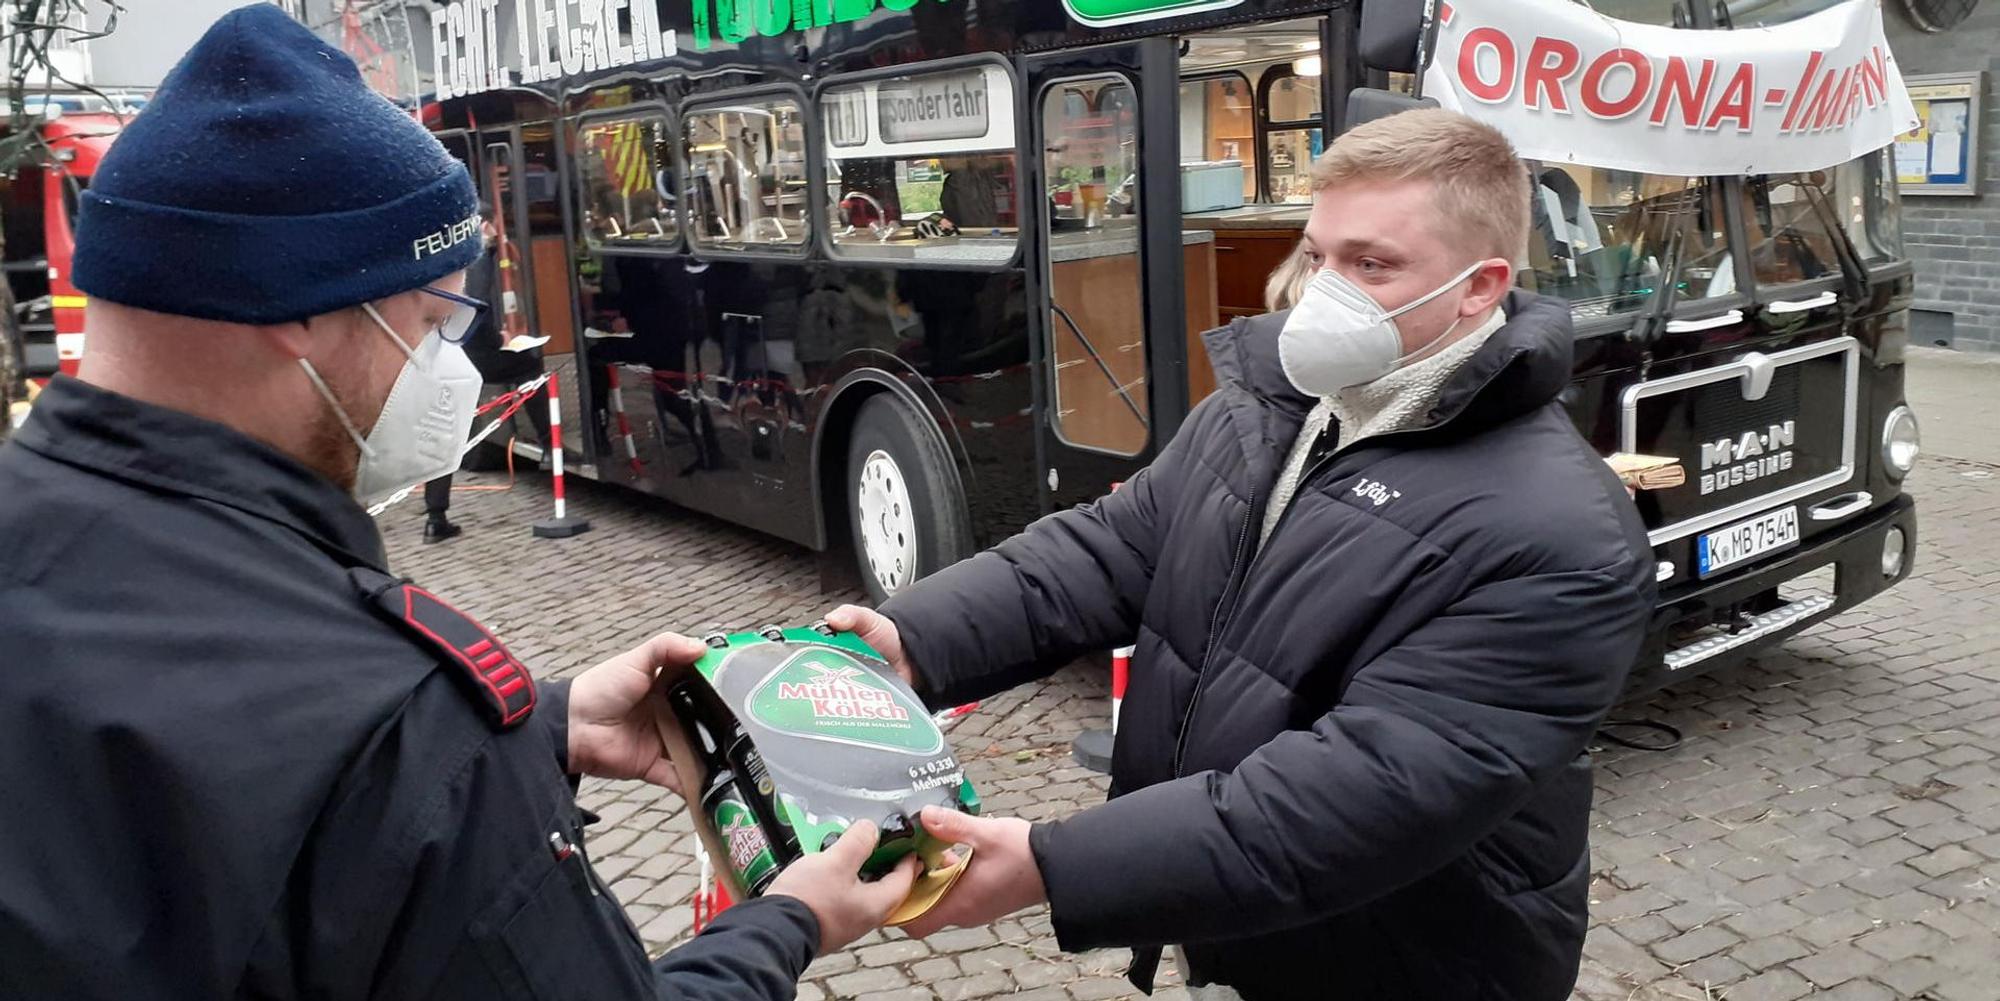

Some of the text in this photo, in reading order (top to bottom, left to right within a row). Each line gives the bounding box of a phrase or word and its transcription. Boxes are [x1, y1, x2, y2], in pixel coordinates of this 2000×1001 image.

[1709, 511, 1796, 567] K MB 754H
[778, 681, 894, 704] Mühlen
[812, 700, 909, 721] Kölsch
[908, 766, 918, 778] 6
[911, 771, 964, 793] Mehrweg
